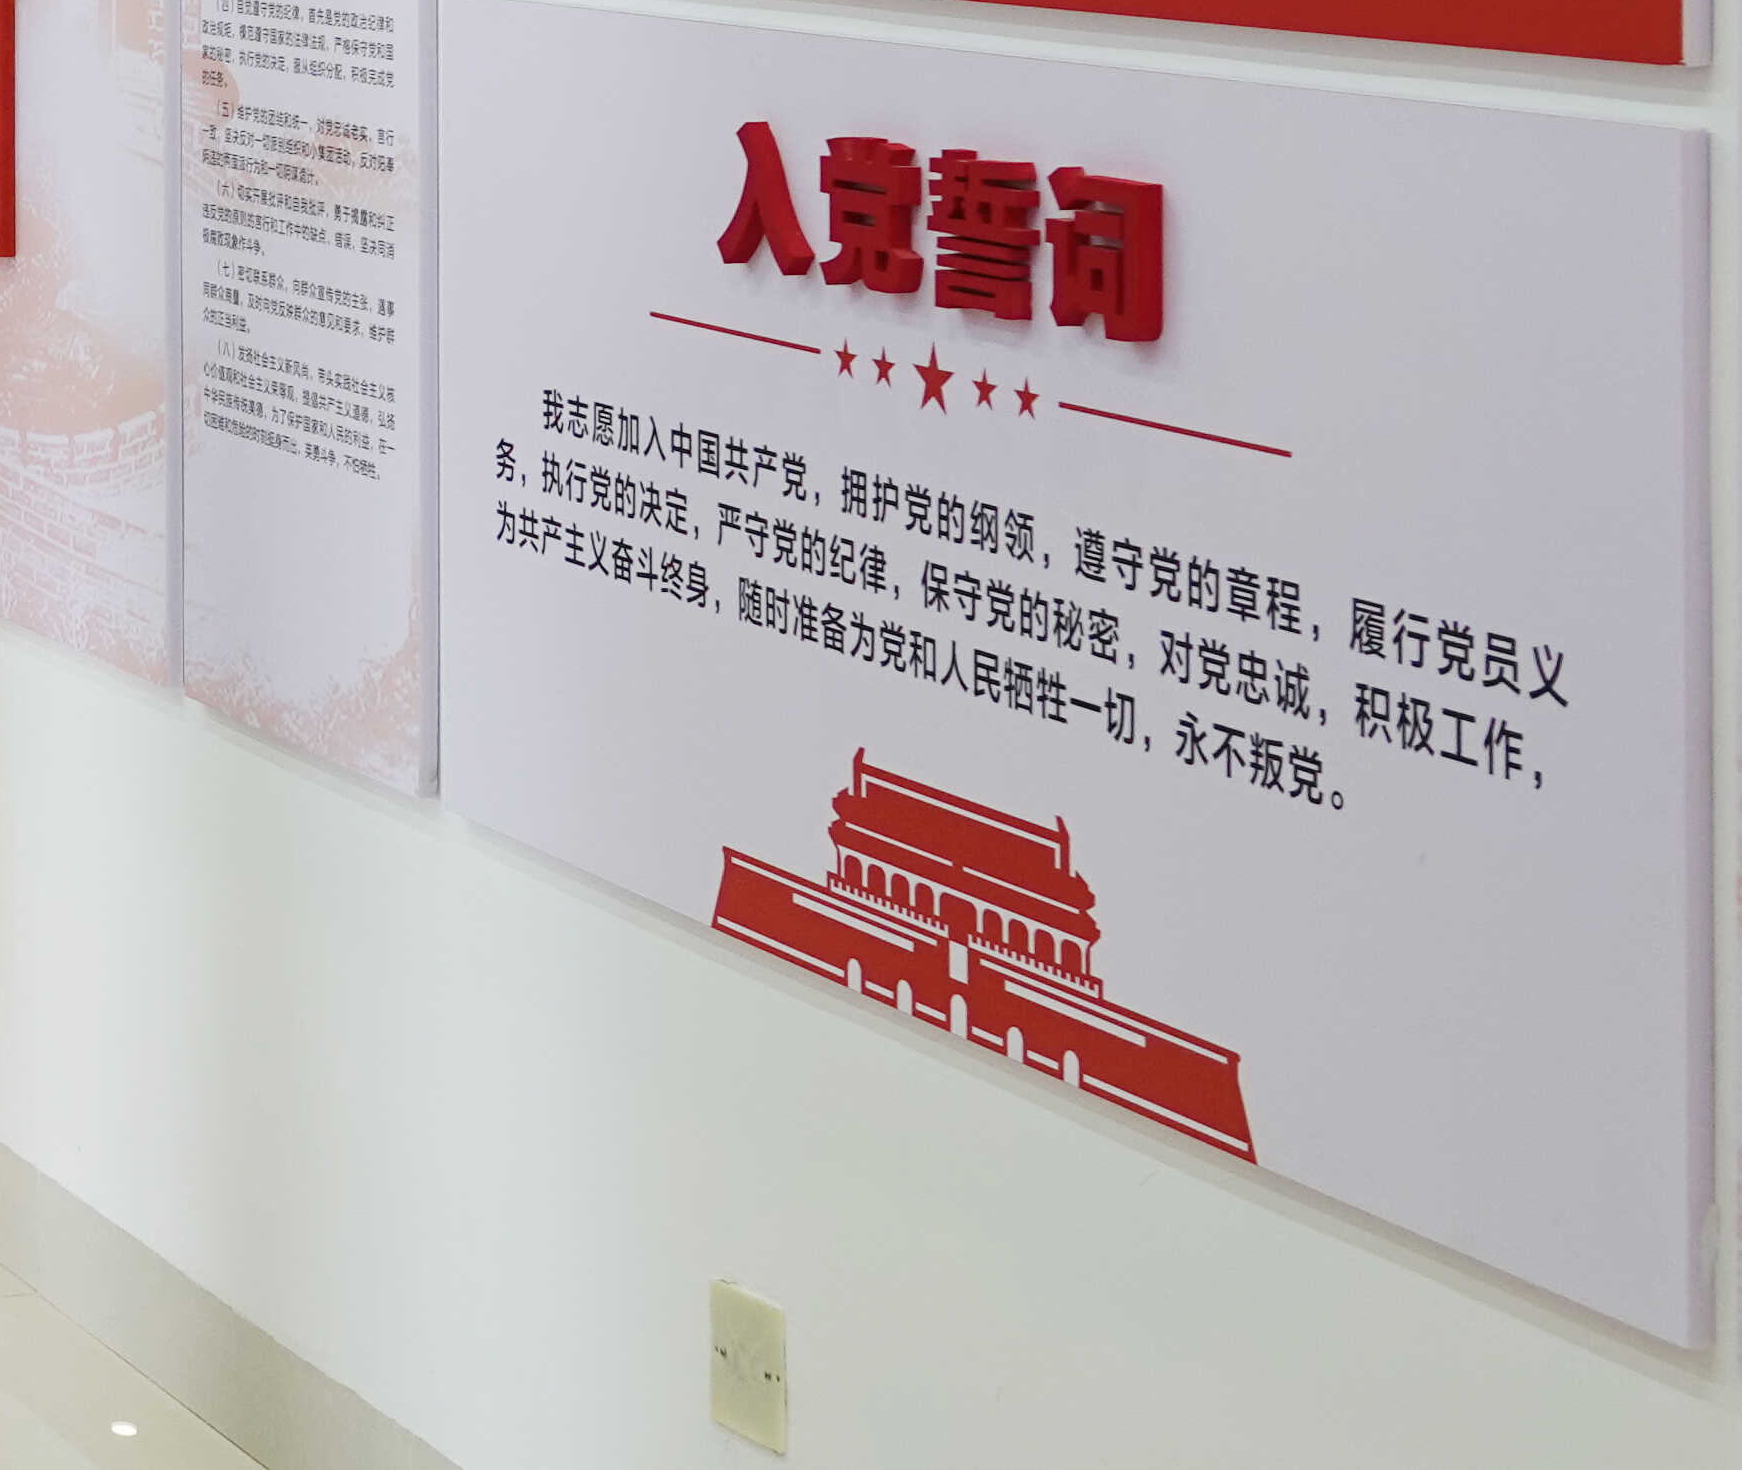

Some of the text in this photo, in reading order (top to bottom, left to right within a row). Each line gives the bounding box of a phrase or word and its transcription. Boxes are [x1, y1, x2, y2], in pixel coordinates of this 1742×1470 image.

[717, 121, 1164, 343] 入党誓词
[495, 437, 1544, 790] 务，执行党的决定，严守党的纪律，保守党的秘密，对党忠诚，积极工作，
[495, 500, 1345, 811] 为共产主义奋斗终身，随时准备为党和人民牺牲一切，永不叛党。
[542, 388, 1569, 709] 我志愿加入中国共产党，拥护党的纲领，遵守党的章程，履行党员义
